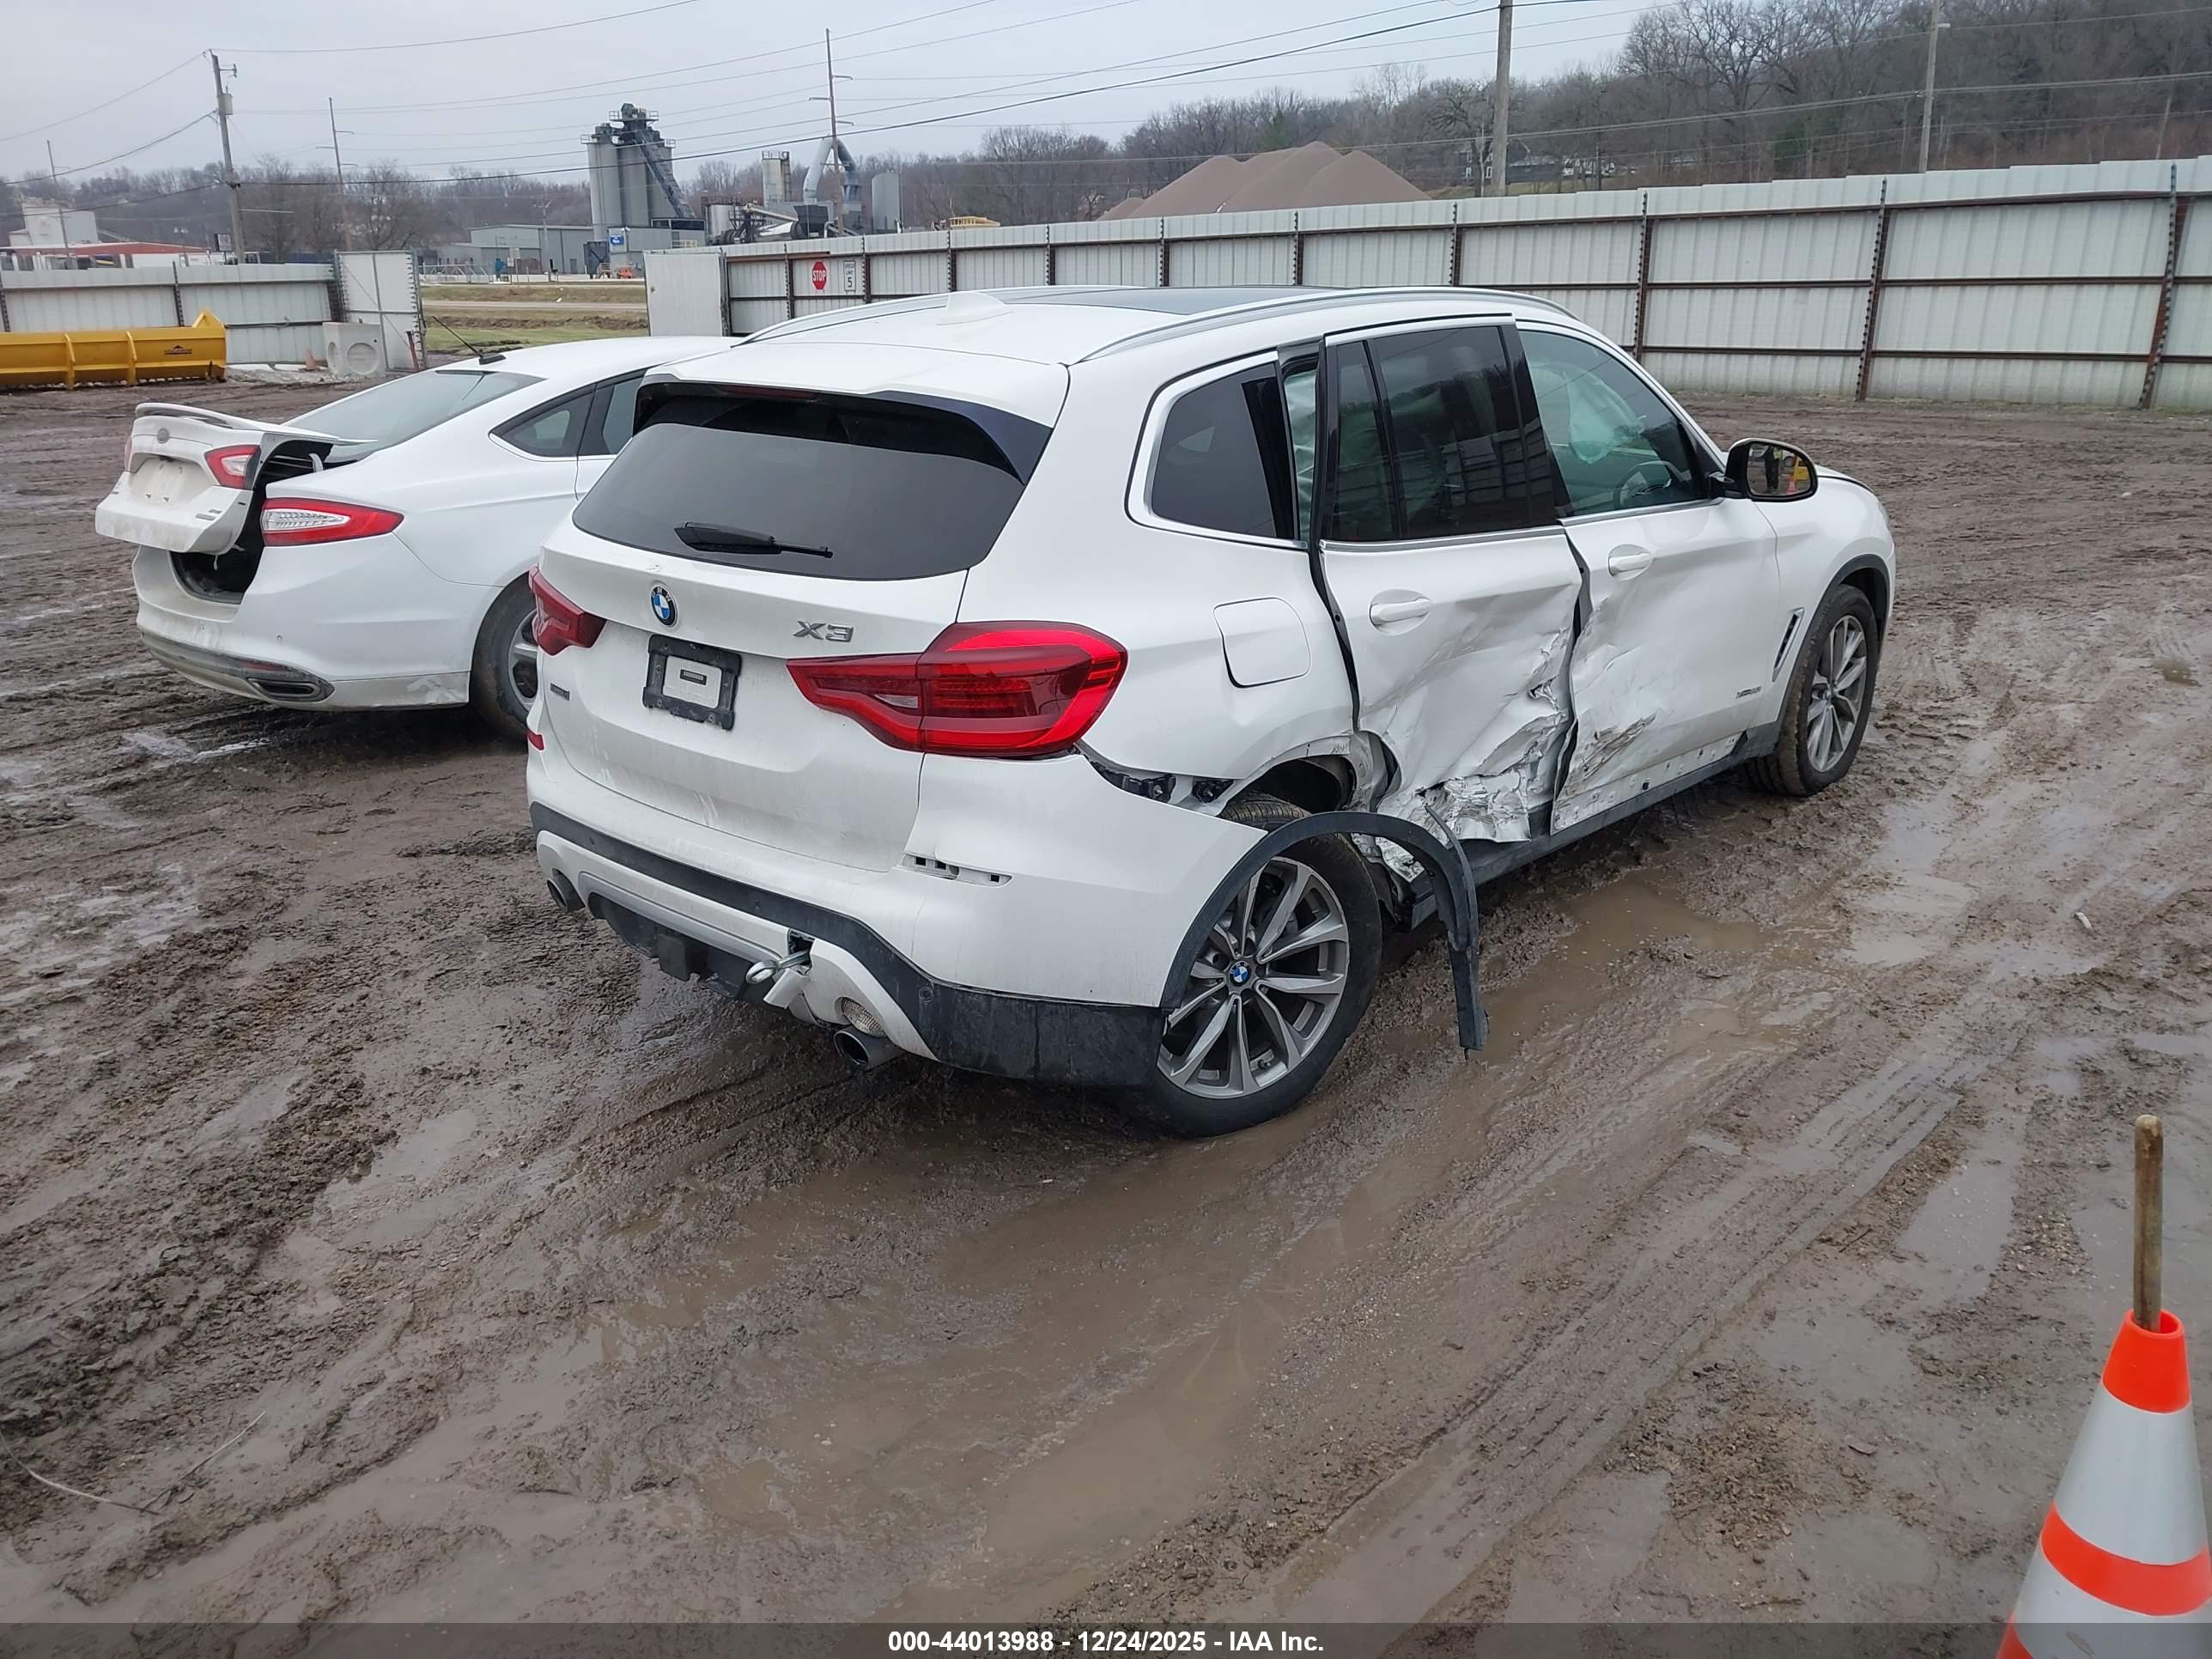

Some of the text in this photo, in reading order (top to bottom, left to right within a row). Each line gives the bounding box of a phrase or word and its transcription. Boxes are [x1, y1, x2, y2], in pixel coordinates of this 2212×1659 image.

[812, 270, 826, 282] STOP
[847, 276, 853, 288] 5
[793, 620, 854, 642] X3
